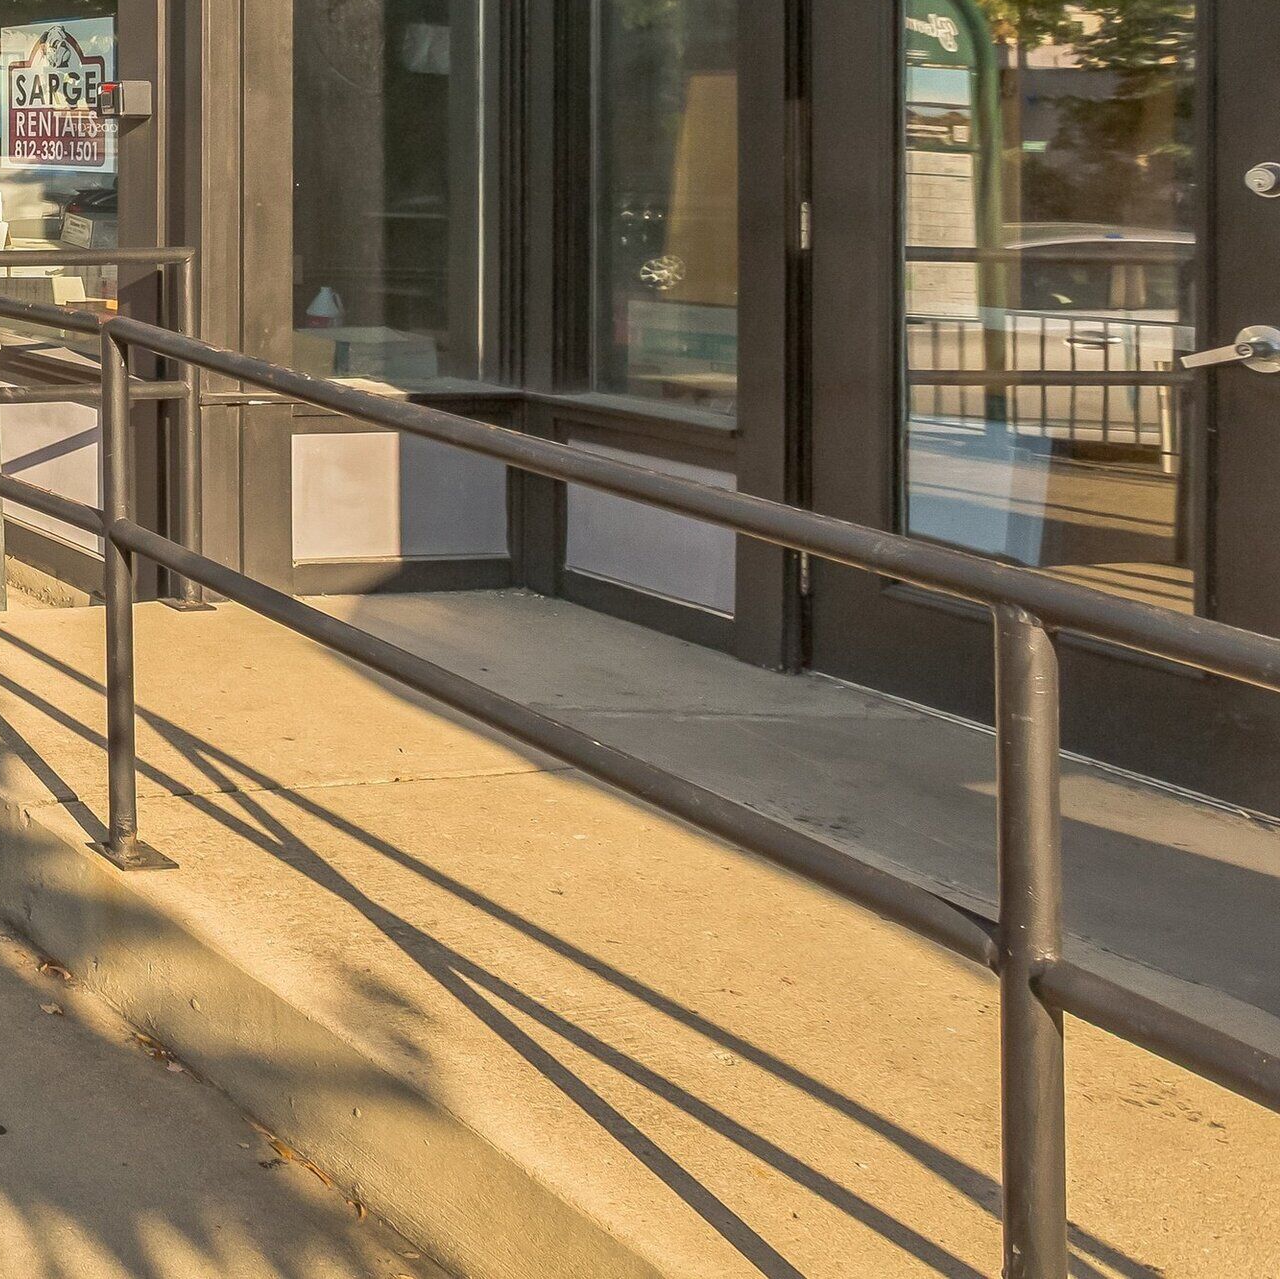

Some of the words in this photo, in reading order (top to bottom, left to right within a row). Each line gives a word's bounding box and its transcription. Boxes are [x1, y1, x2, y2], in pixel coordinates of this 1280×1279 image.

[15, 71, 96, 106] SARGE
[16, 110, 98, 138] RENTALS
[14, 140, 98, 161] 812-330-1501
